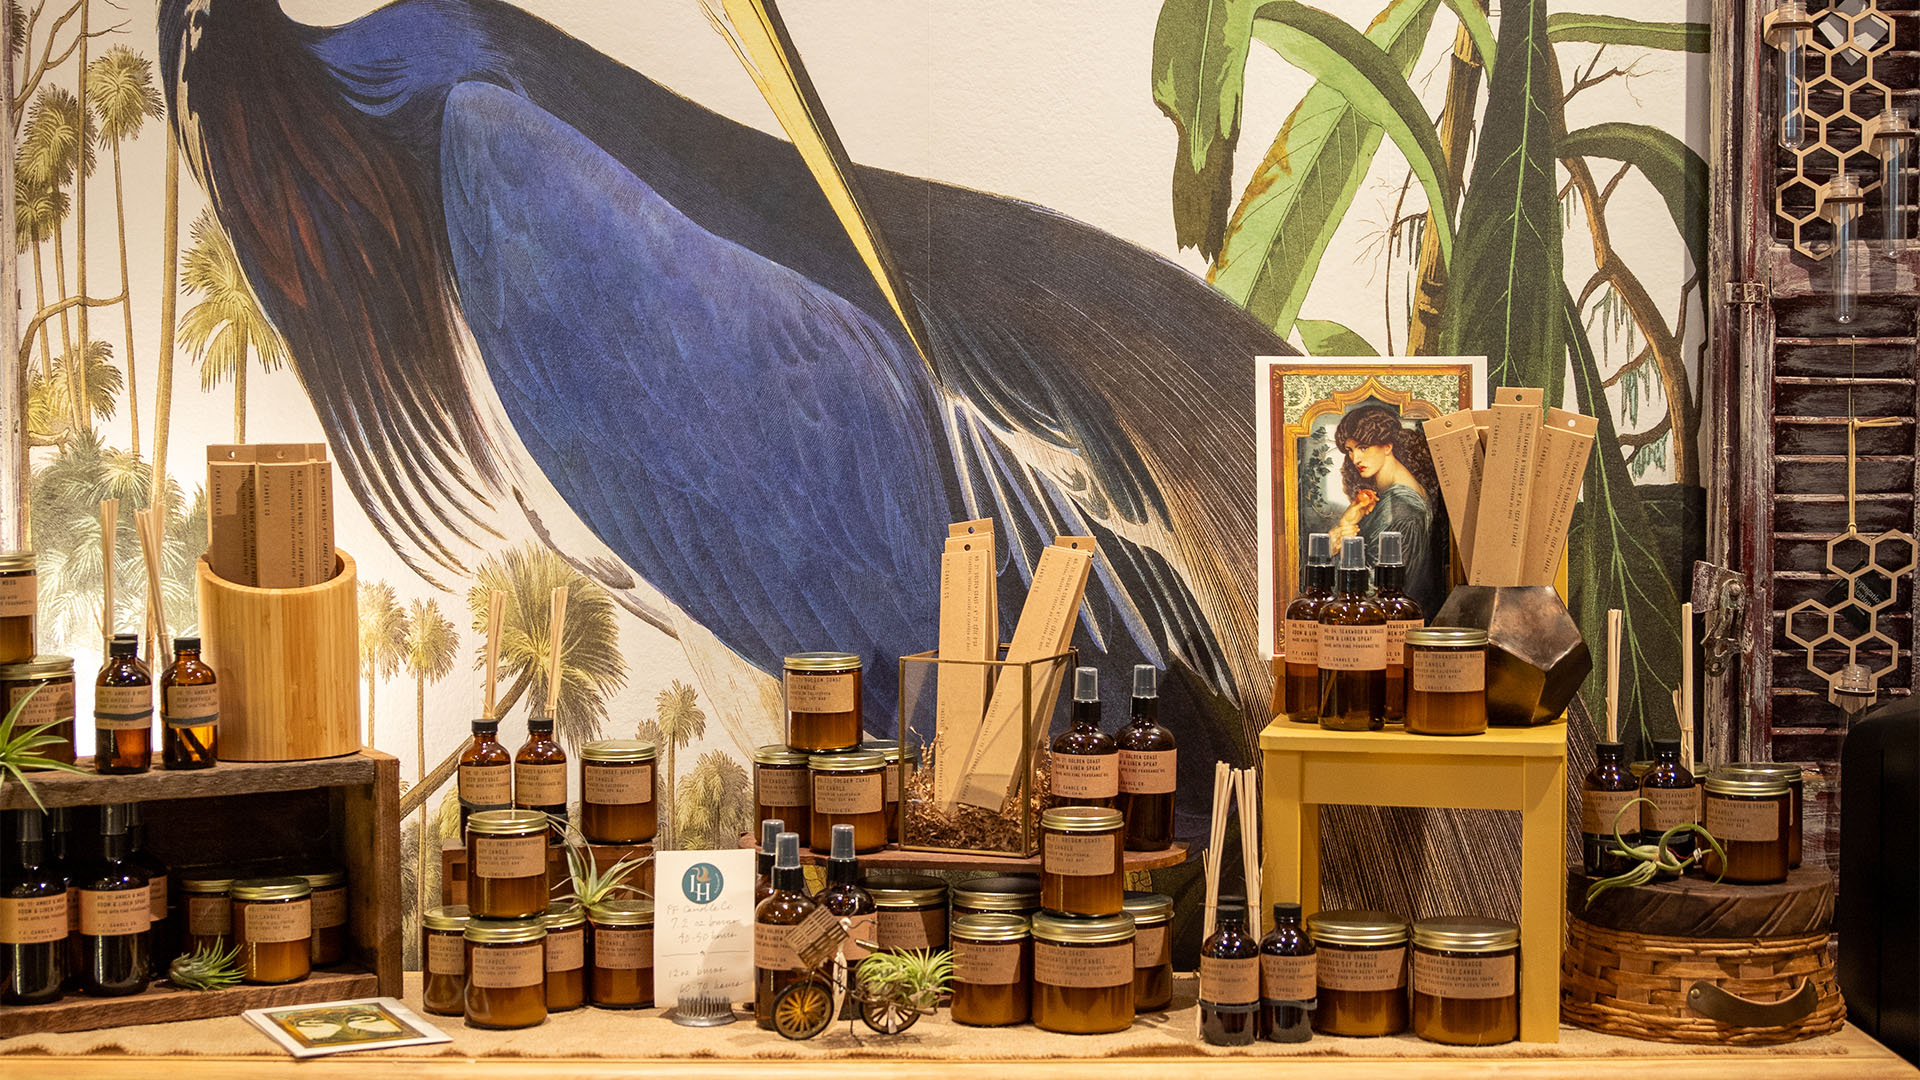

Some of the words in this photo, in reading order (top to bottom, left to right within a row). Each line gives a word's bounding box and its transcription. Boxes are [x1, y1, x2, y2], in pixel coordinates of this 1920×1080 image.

[1522, 432, 1530, 457] TEAKWOOD
[1438, 456, 1448, 478] CANDLE
[1538, 446, 1548, 468] CANDLE
[1568, 461, 1579, 485] TEAKWOOD
[1560, 492, 1570, 513] TOBACCO
